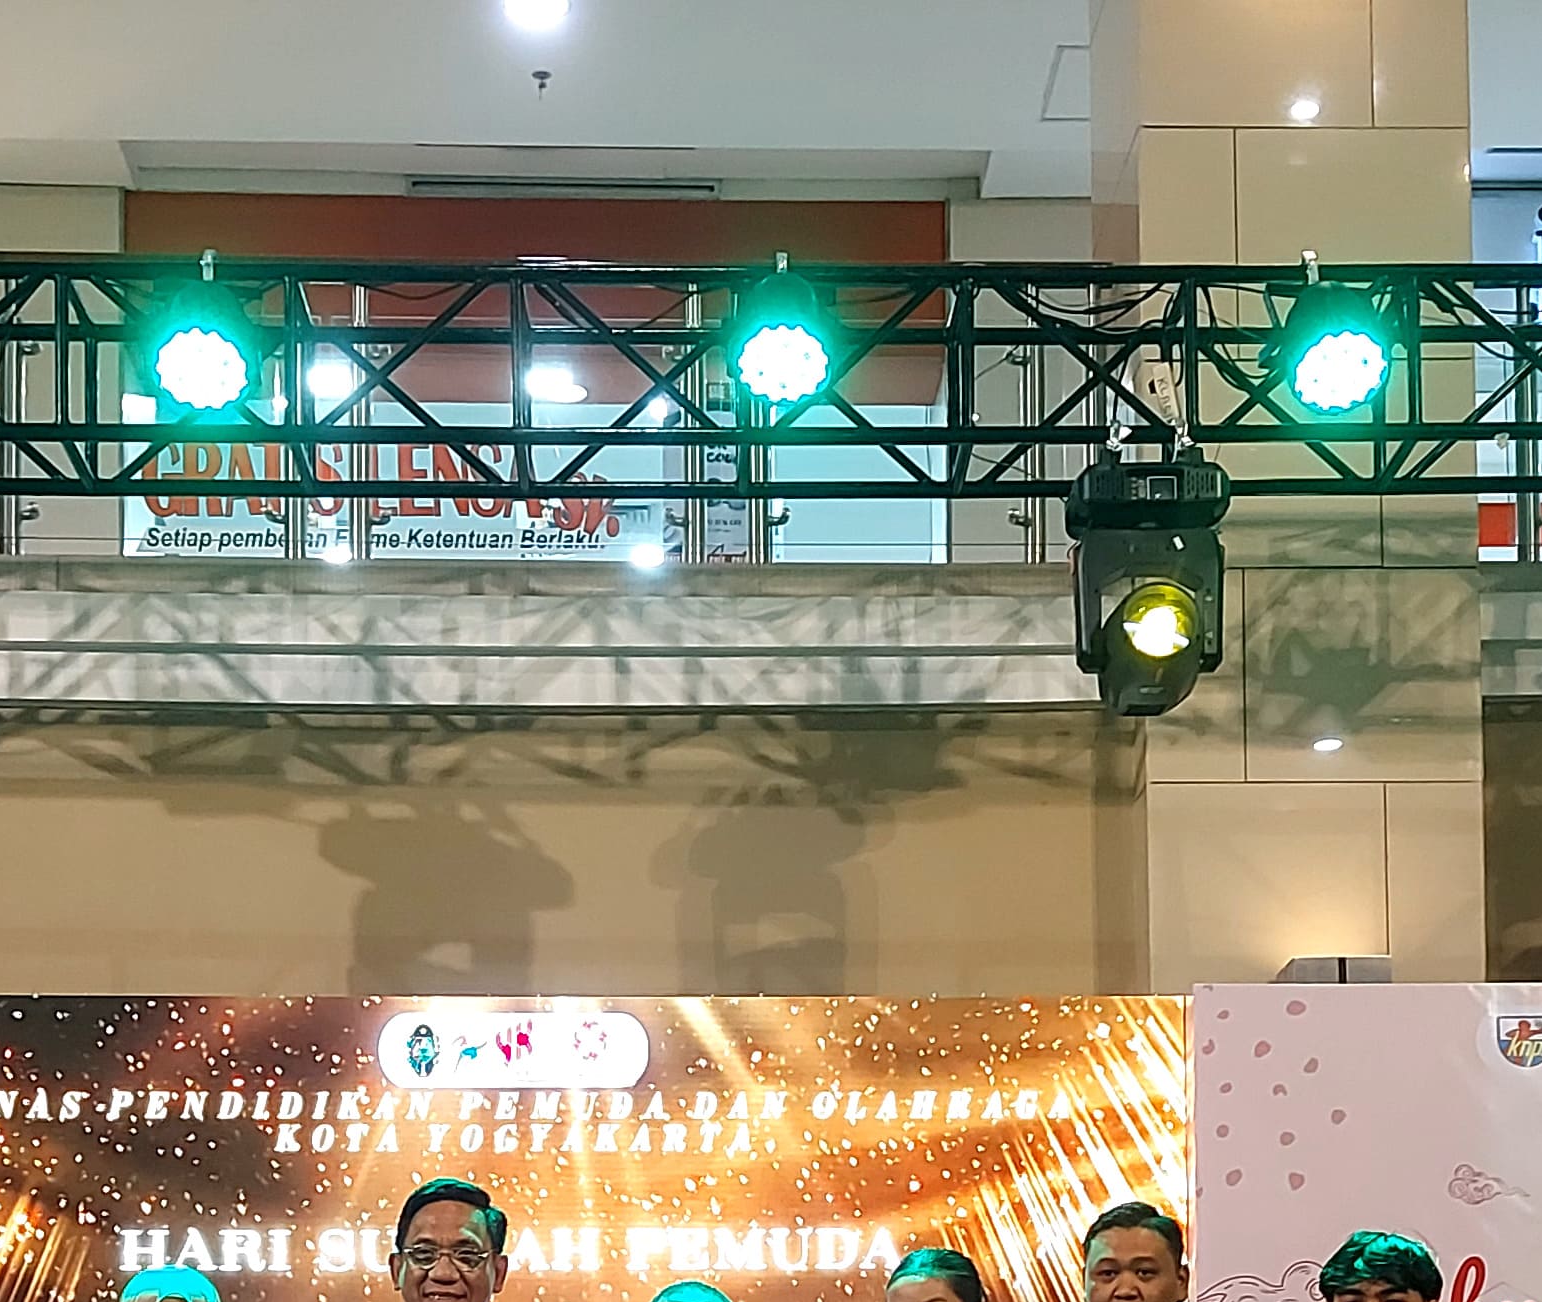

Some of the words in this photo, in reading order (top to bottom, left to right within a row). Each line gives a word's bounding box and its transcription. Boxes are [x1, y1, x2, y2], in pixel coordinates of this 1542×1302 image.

[141, 442, 343, 517] GRATS
[146, 526, 212, 552] Setiap
[218, 527, 327, 552] pembean
[335, 529, 399, 549] Fme
[407, 528, 513, 549] Ketentuan
[106, 1089, 434, 1121] PENDIDIKAN
[459, 1089, 665, 1121] PEMUDA
[693, 1090, 789, 1121] DAN
[811, 1090, 1072, 1121] OLAHRAGA
[274, 1123, 399, 1153] KOTA
[428, 1122, 753, 1154] YOGYAKARTA
[116, 1227, 292, 1272] HARI
[318, 1227, 601, 1273] SUAH
[625, 1226, 904, 1272] PEMUDA
